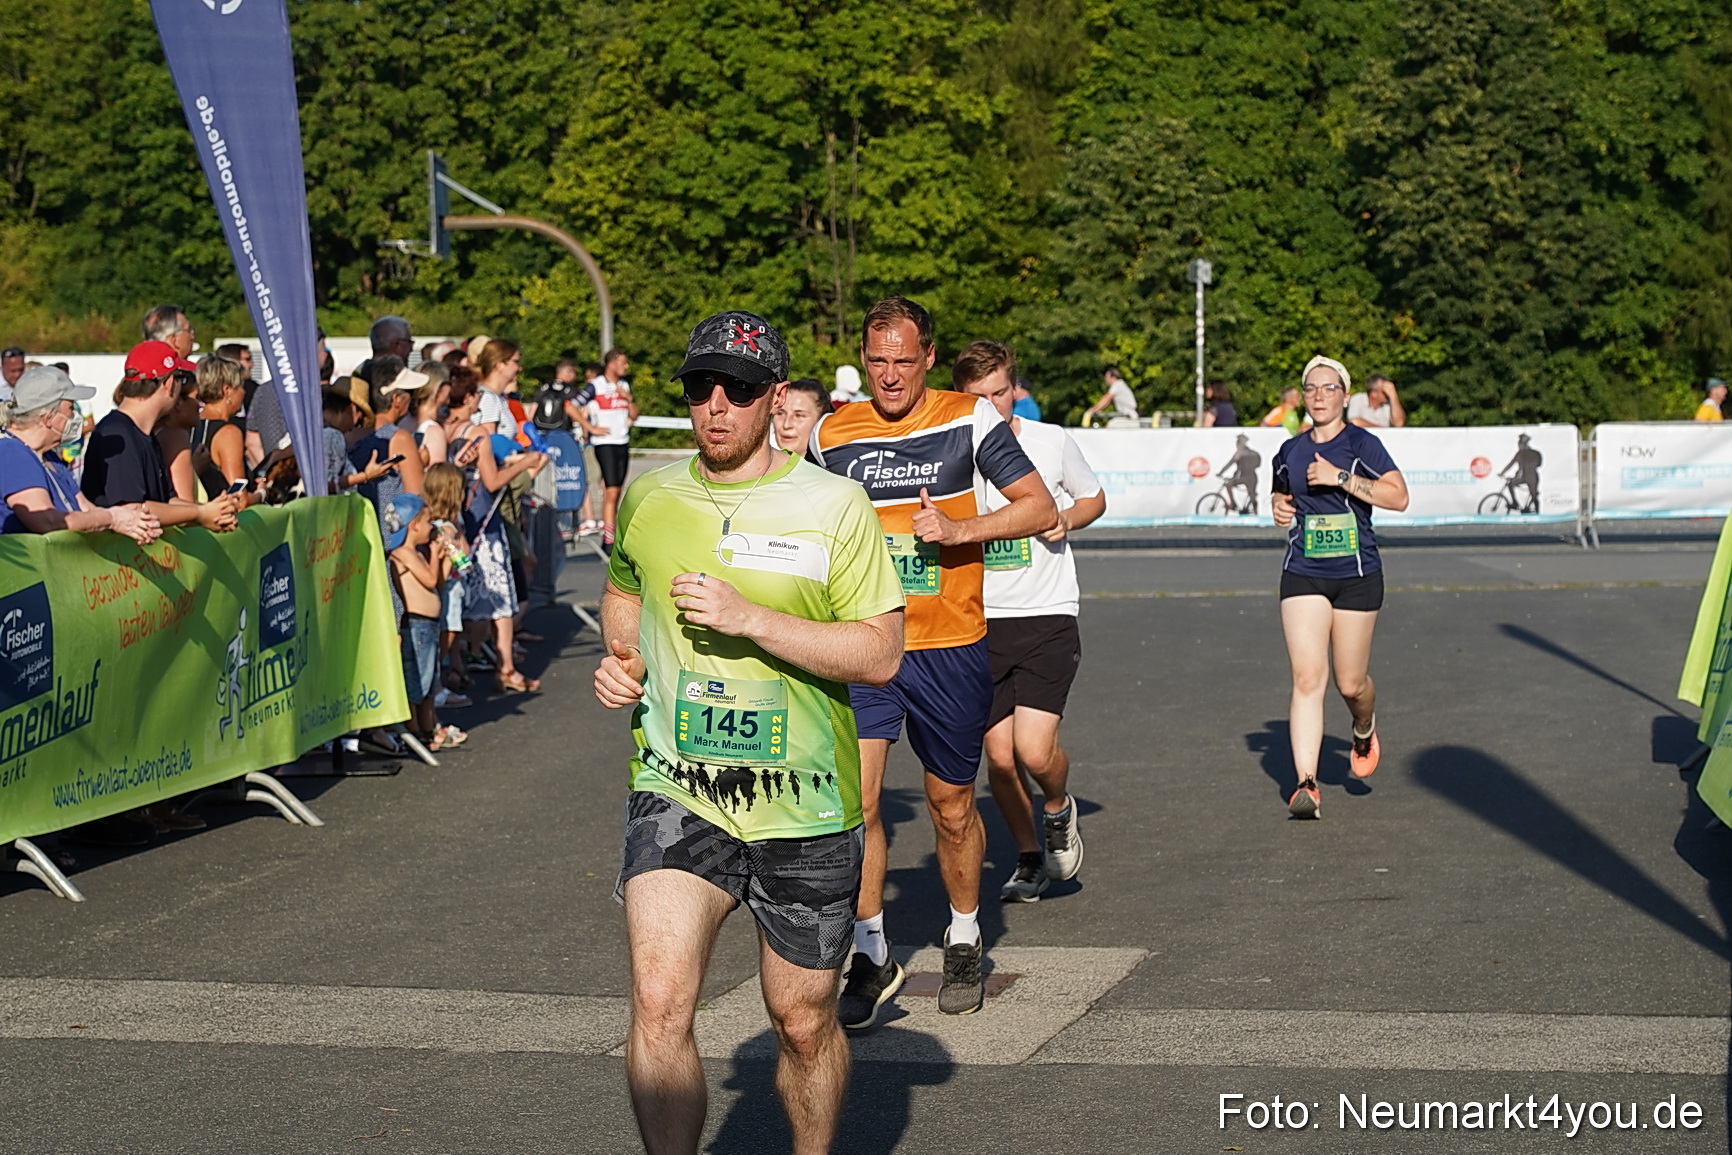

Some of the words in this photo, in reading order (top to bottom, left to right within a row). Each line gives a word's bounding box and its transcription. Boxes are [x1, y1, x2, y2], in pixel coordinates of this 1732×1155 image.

[1621, 446, 1656, 458] NOW
[863, 461, 943, 480] Fischer
[871, 476, 938, 489] AUTOMOBILE
[1316, 530, 1344, 543] 953
[767, 548, 797, 558] Neumarkt
[768, 541, 799, 551] Klinikum
[985, 540, 1013, 554] 00
[891, 555, 926, 576] 19
[927, 559, 936, 587] 2022
[6, 622, 45, 651] Fischer
[702, 691, 737, 701] Firmenlauf
[680, 710, 689, 741] RUN
[701, 706, 758, 739] 145
[770, 715, 782, 754] 2022
[694, 735, 719, 749] Marx
[721, 740, 762, 751] Manuel
